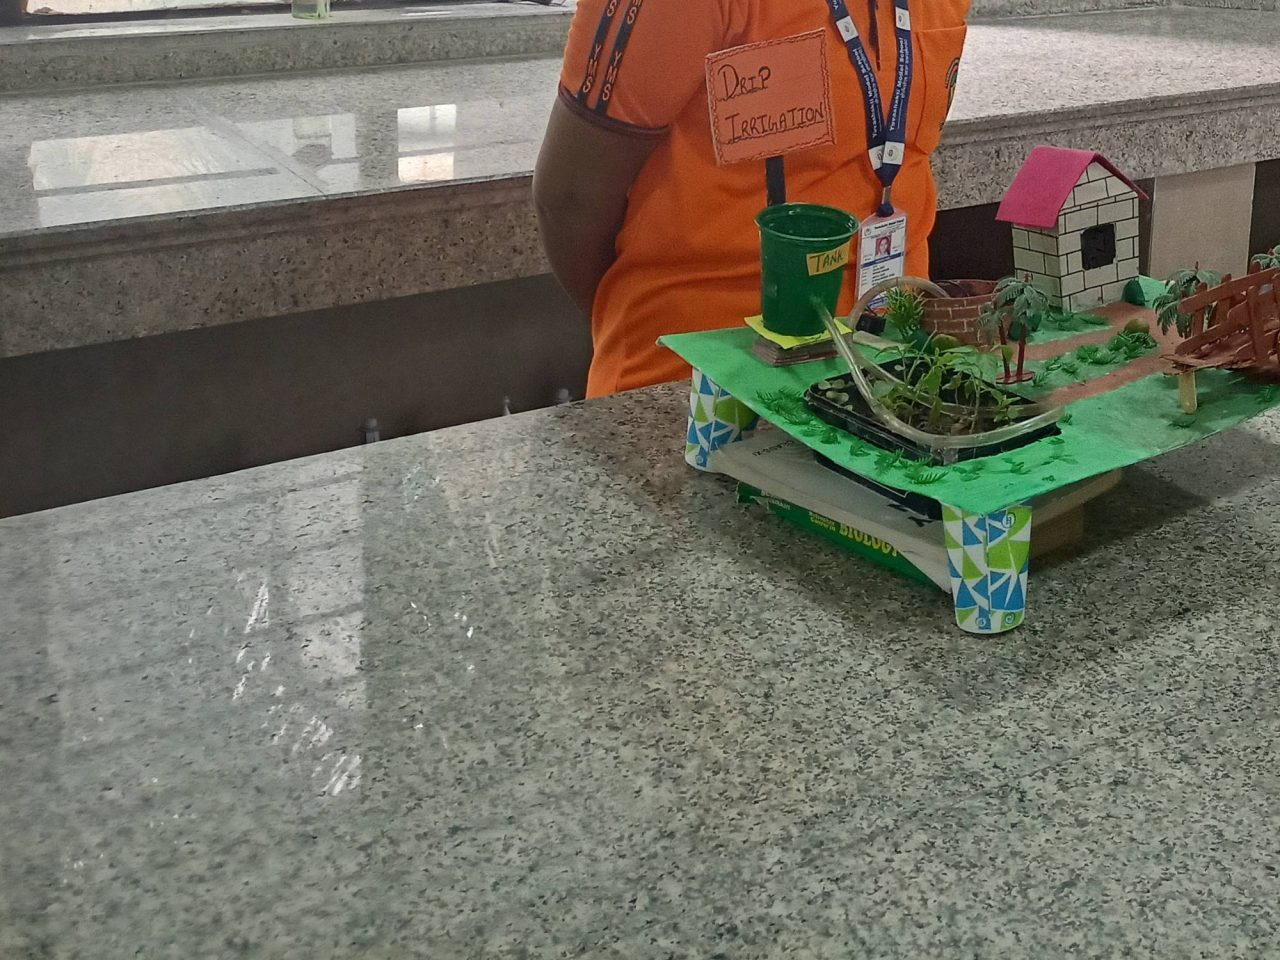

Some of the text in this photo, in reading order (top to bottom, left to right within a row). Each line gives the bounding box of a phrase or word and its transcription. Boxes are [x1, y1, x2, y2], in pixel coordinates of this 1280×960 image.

[582, 43, 602, 93] YMS
[601, 50, 623, 101] YMS
[716, 63, 772, 101] DRIP
[725, 102, 824, 144] IRRIGATION
[809, 250, 843, 273] TANK
